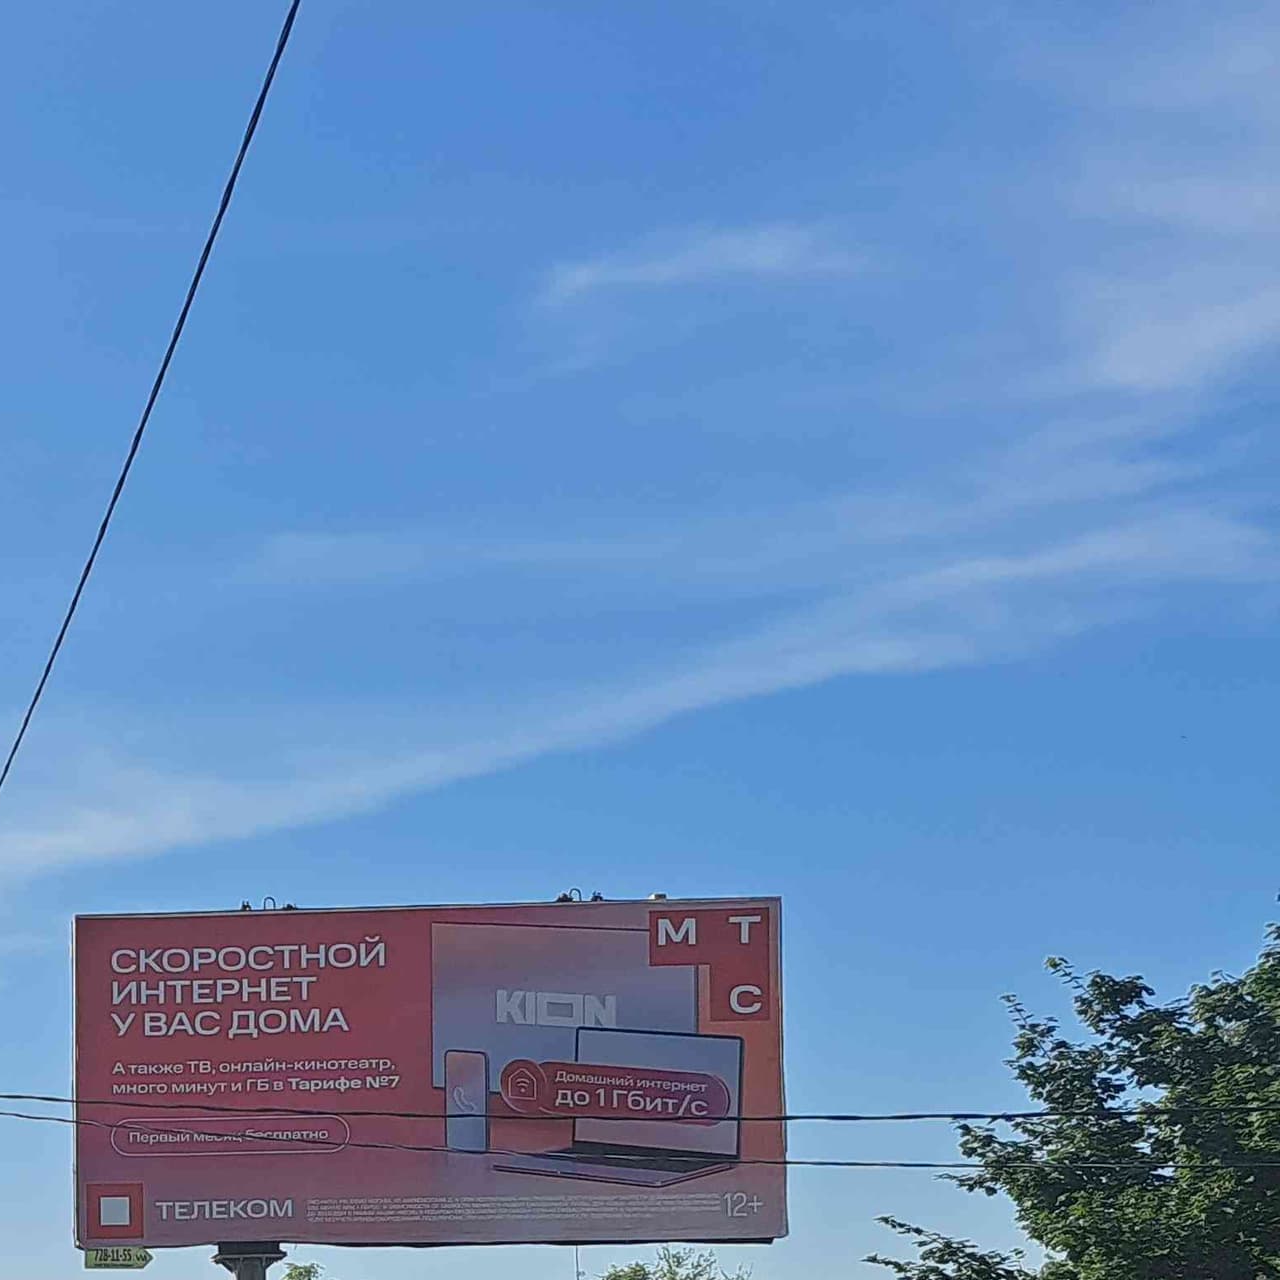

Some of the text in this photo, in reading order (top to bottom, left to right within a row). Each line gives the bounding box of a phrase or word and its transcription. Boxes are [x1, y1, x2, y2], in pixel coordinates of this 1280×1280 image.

[110, 935, 386, 974] СКОРОСТНОЙ
[111, 976, 317, 1005] ИНТЕРНЕТ
[495, 989, 617, 1027] KION
[111, 1007, 350, 1040] У ВАС ДОМА
[112, 1057, 396, 1075] А также ТВ, онлайн-кинотеатр,
[112, 1075, 400, 1096] много минут и ГБ в Тарифе №7
[554, 1070, 708, 1093] Домашний интернет
[554, 1088, 709, 1116] до 1 Гбит/с
[128, 1129, 190, 1144] Первый
[155, 1198, 294, 1221] ТЕЛЕКОМ
[723, 1191, 764, 1217] 12+
